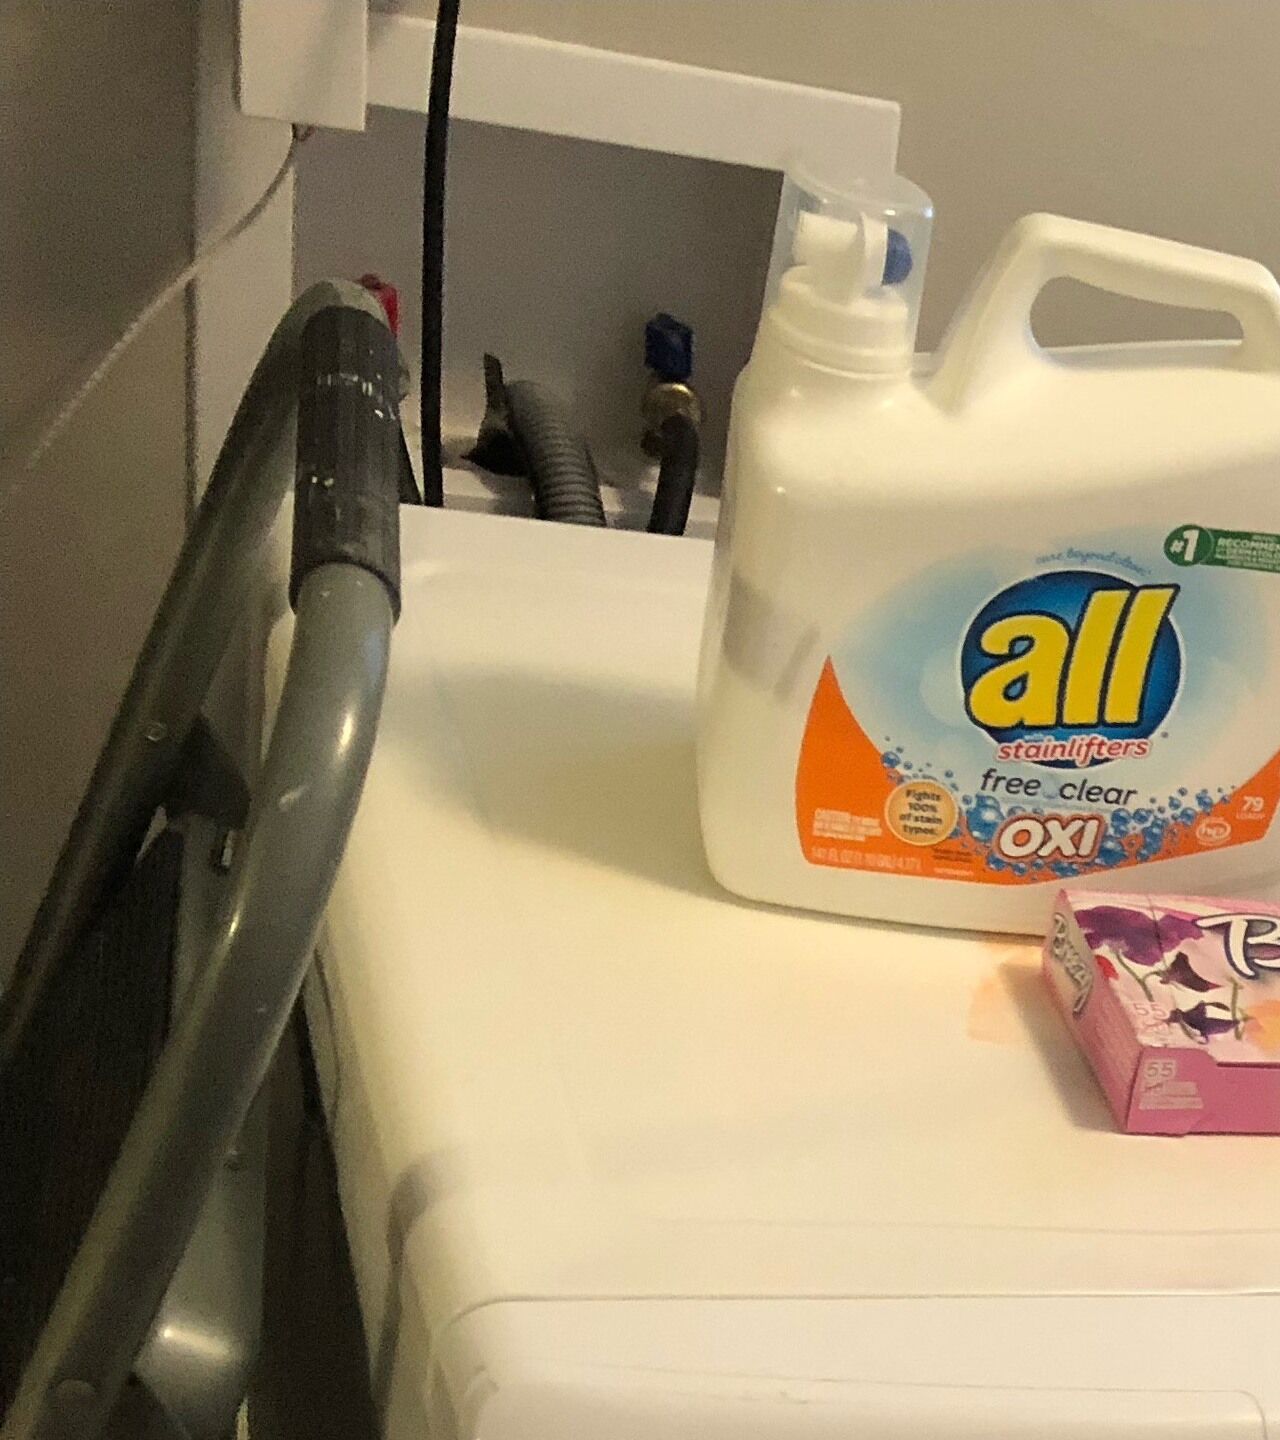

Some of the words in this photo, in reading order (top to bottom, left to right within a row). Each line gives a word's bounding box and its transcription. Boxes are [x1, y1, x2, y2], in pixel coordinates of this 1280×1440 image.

[1169, 529, 1199, 562] #1
[966, 585, 1179, 728] all
[998, 734, 1149, 765] stainlifters
[905, 789, 941, 801] Fights
[981, 768, 1041, 796] free
[1059, 778, 1138, 806] clear
[908, 801, 938, 813] 100%
[1242, 796, 1264, 813] 79
[899, 812, 911, 821] of
[914, 813, 943, 824] stain
[999, 817, 1100, 858] OXI
[1146, 1061, 1174, 1077] 55
